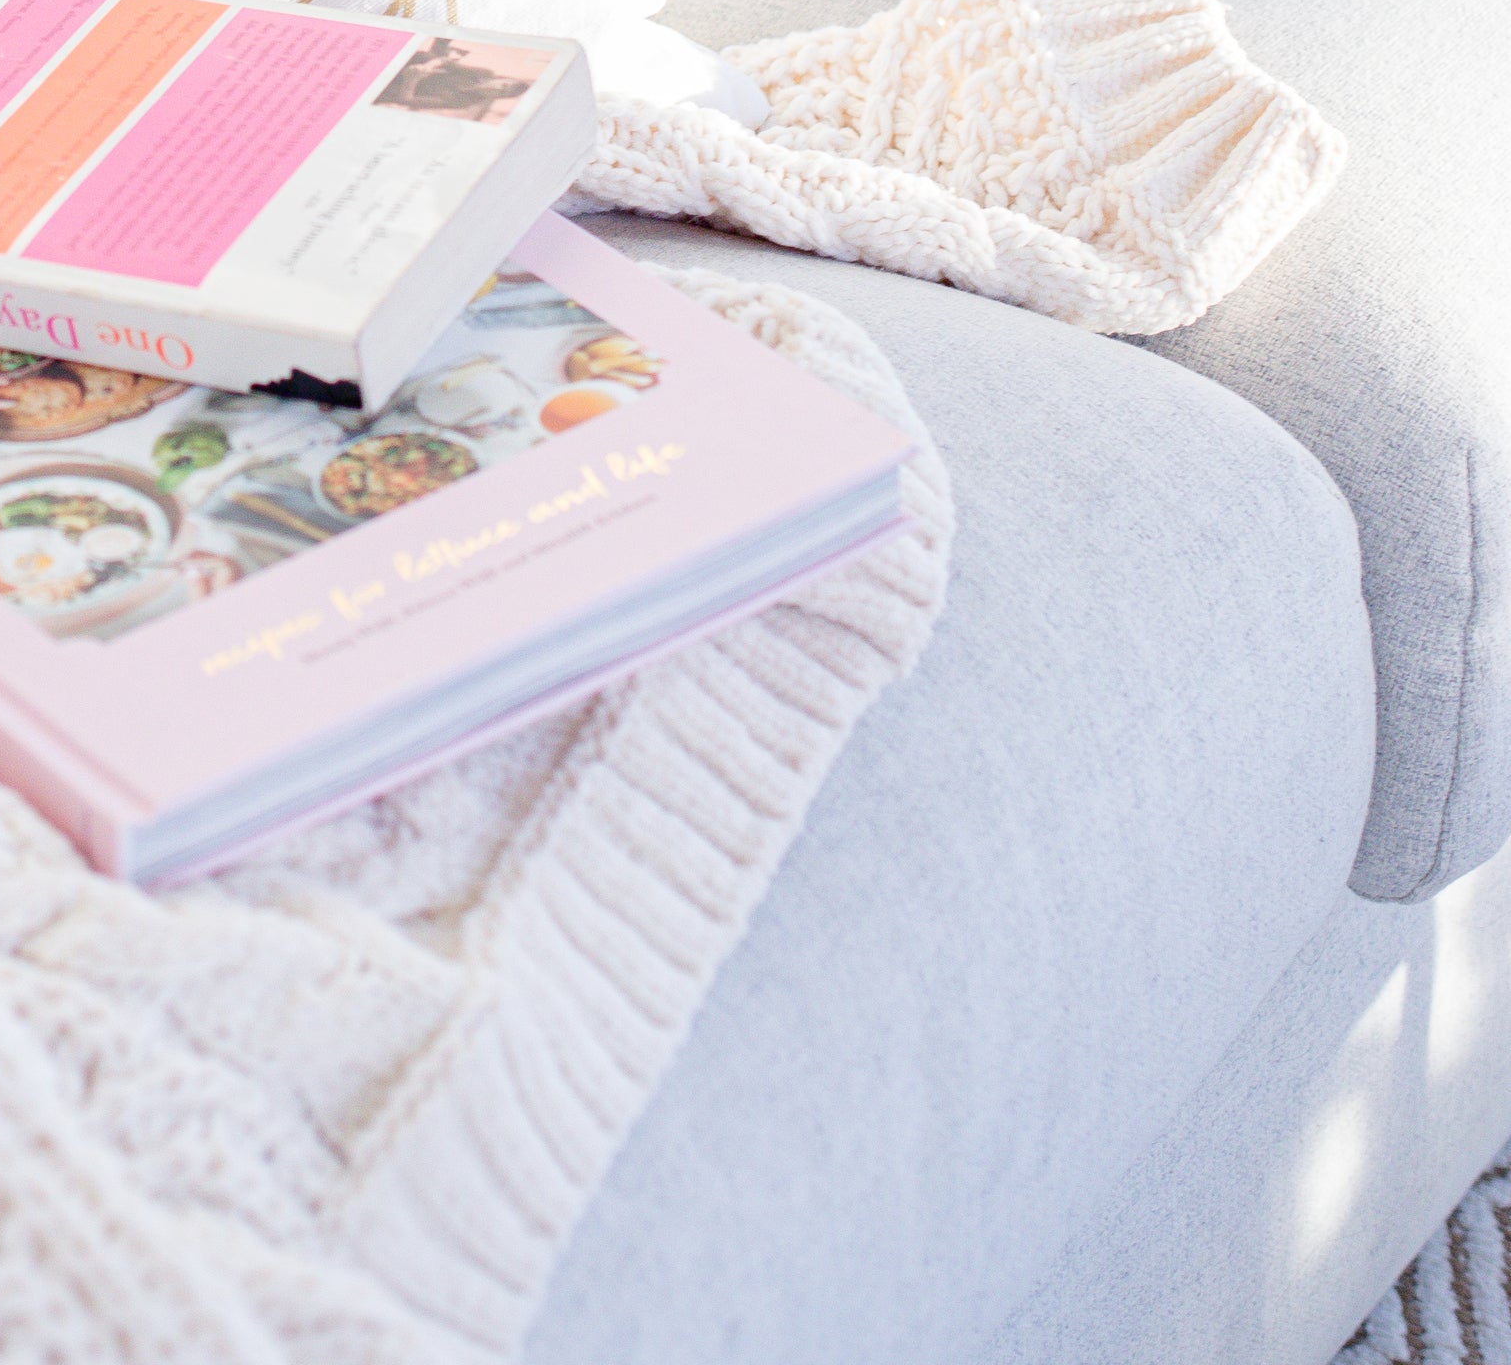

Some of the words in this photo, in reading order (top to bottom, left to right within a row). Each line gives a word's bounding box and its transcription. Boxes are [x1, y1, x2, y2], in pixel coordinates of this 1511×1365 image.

[94, 320, 196, 372] One
[330, 579, 387, 622] for
[527, 464, 612, 525] and
